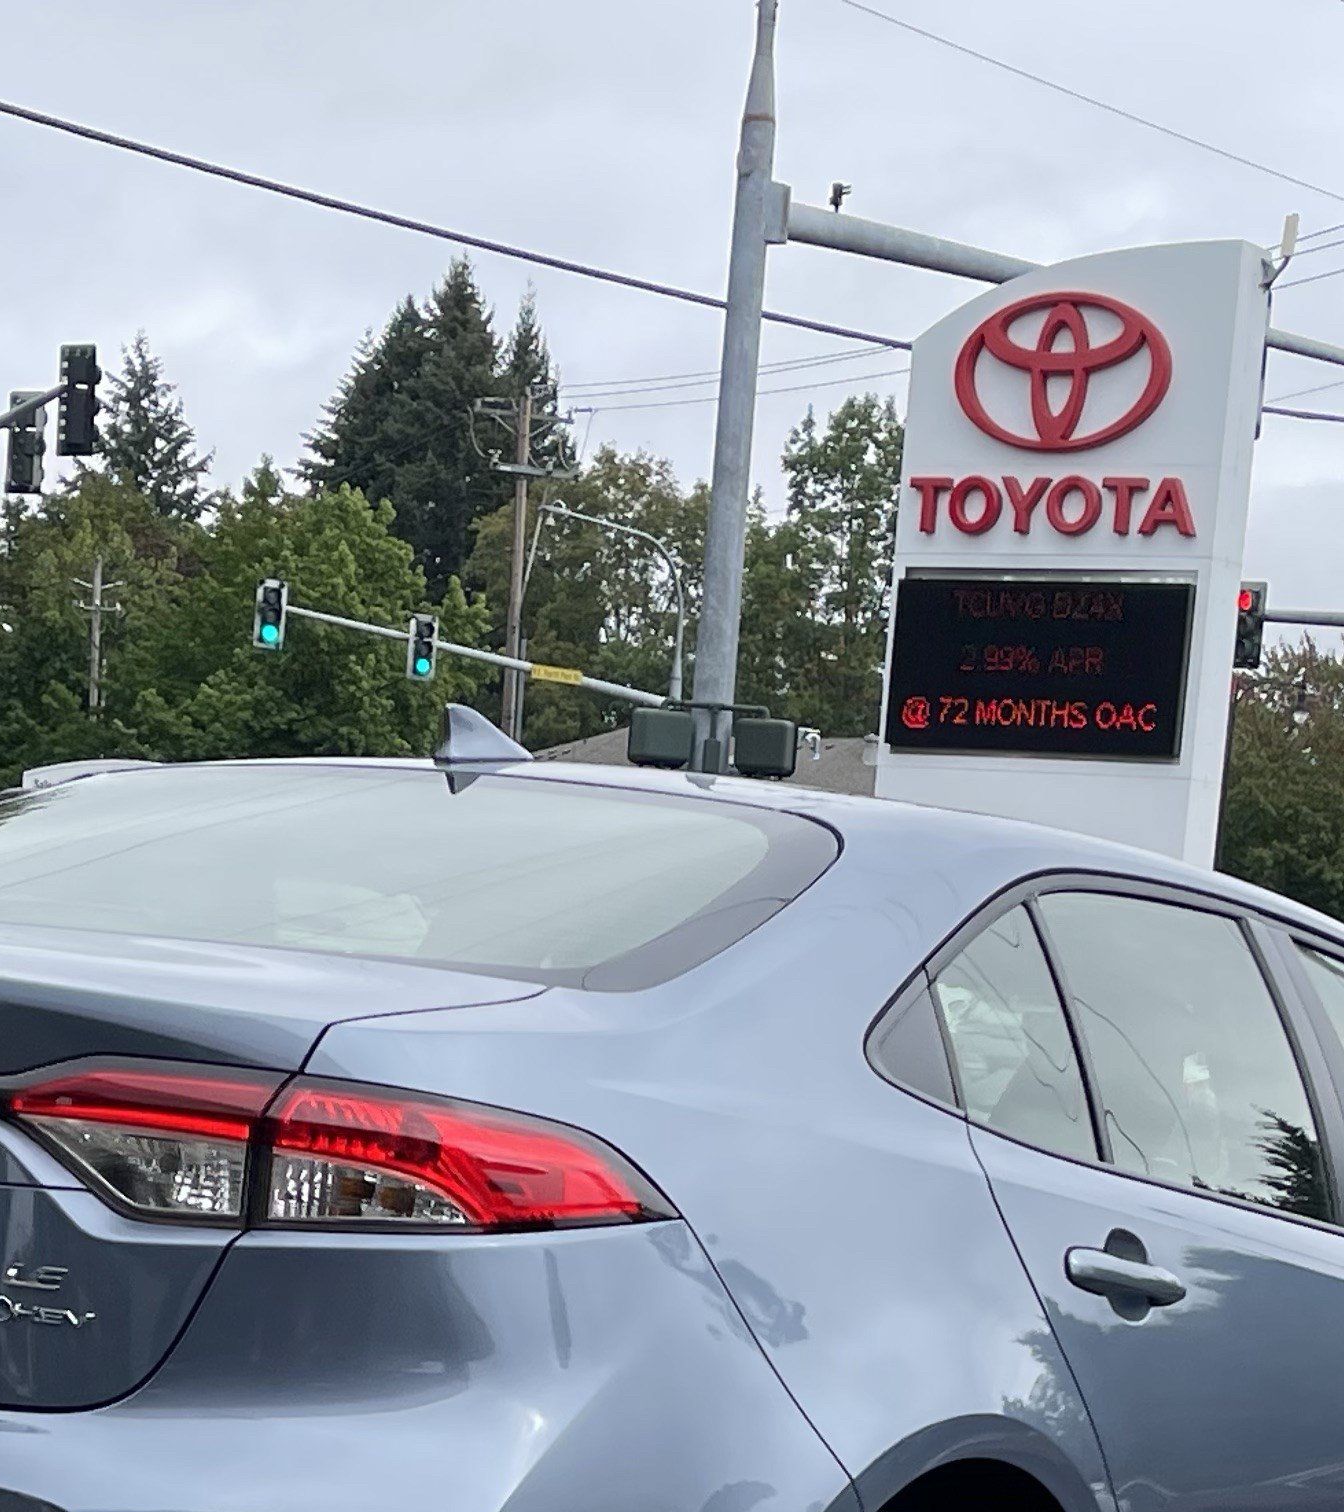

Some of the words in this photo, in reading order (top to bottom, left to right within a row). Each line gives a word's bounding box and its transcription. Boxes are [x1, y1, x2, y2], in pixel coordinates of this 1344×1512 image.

[909, 474, 1197, 538] TOYOTA
[902, 696, 931, 729] @
[939, 697, 969, 725] 72
[975, 698, 1088, 729] MONTHS
[1094, 701, 1158, 732] OAC
